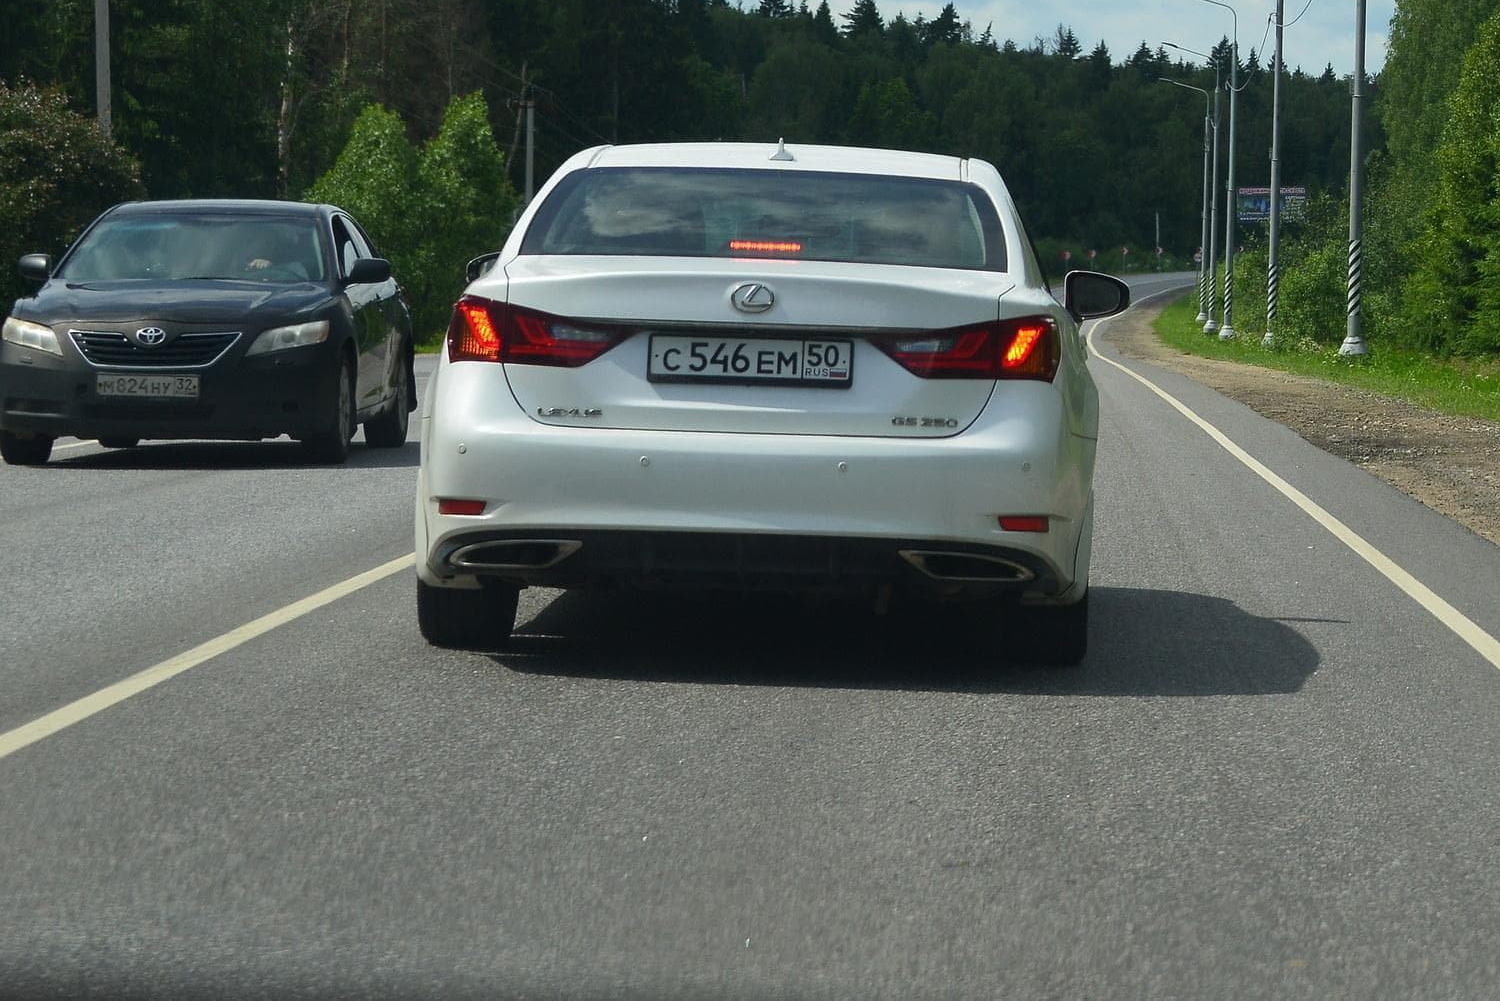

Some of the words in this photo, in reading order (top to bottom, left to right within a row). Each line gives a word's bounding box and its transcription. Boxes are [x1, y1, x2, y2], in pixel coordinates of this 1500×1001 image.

[807, 343, 840, 368] 50
[804, 367, 829, 378] RUS
[176, 378, 194, 391] 32
